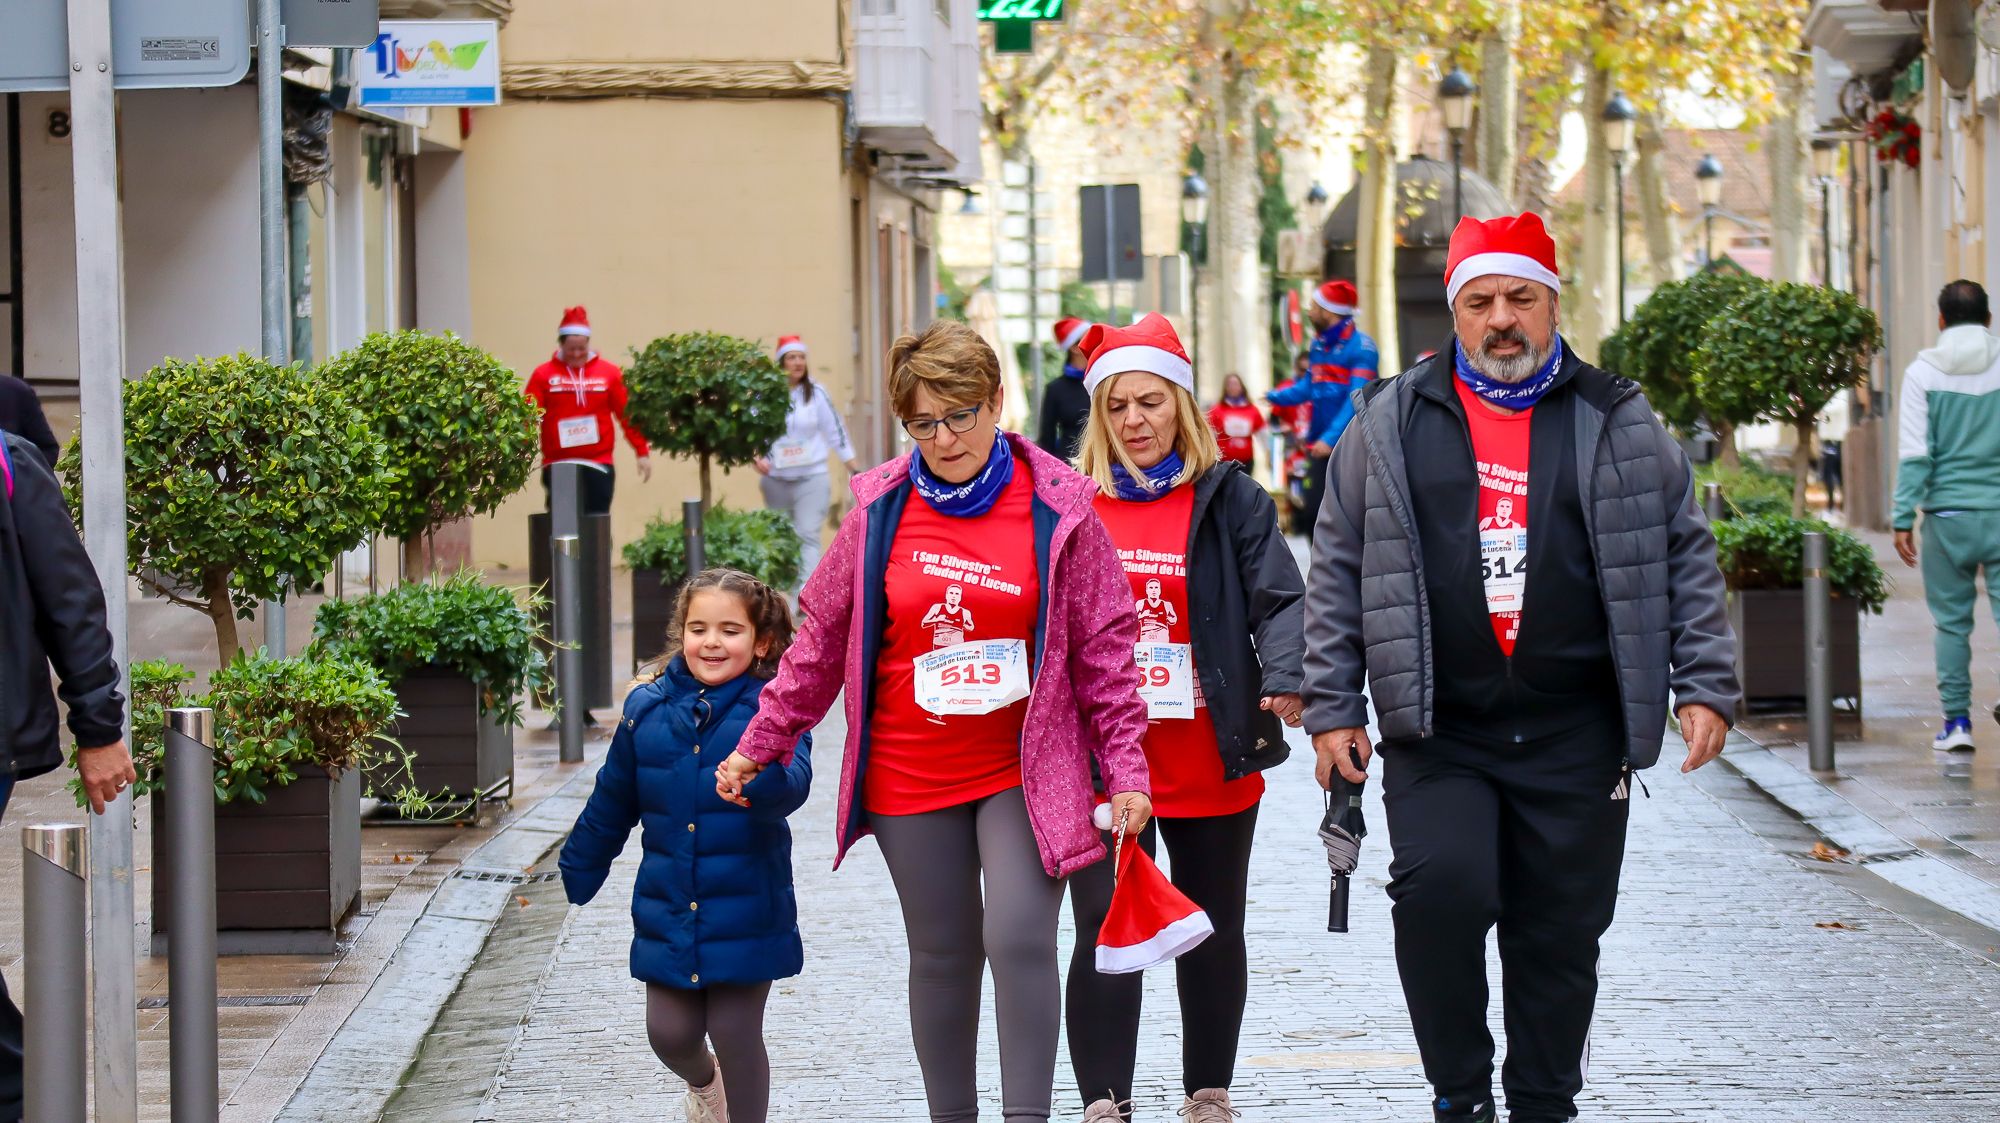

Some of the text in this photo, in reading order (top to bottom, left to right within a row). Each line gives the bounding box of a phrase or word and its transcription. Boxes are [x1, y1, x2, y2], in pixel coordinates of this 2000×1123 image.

[49, 111, 71, 138] 8
[919, 551, 940, 563] San
[941, 554, 991, 575] Silvestre
[1136, 549, 1183, 564] Silvestre
[1159, 564, 1174, 575] de
[923, 564, 1022, 597] Ciudad de Lucena
[925, 659, 938, 667] San
[938, 651, 966, 662] Silvestre
[926, 661, 947, 672] Ciudad
[941, 664, 1001, 687] 513
